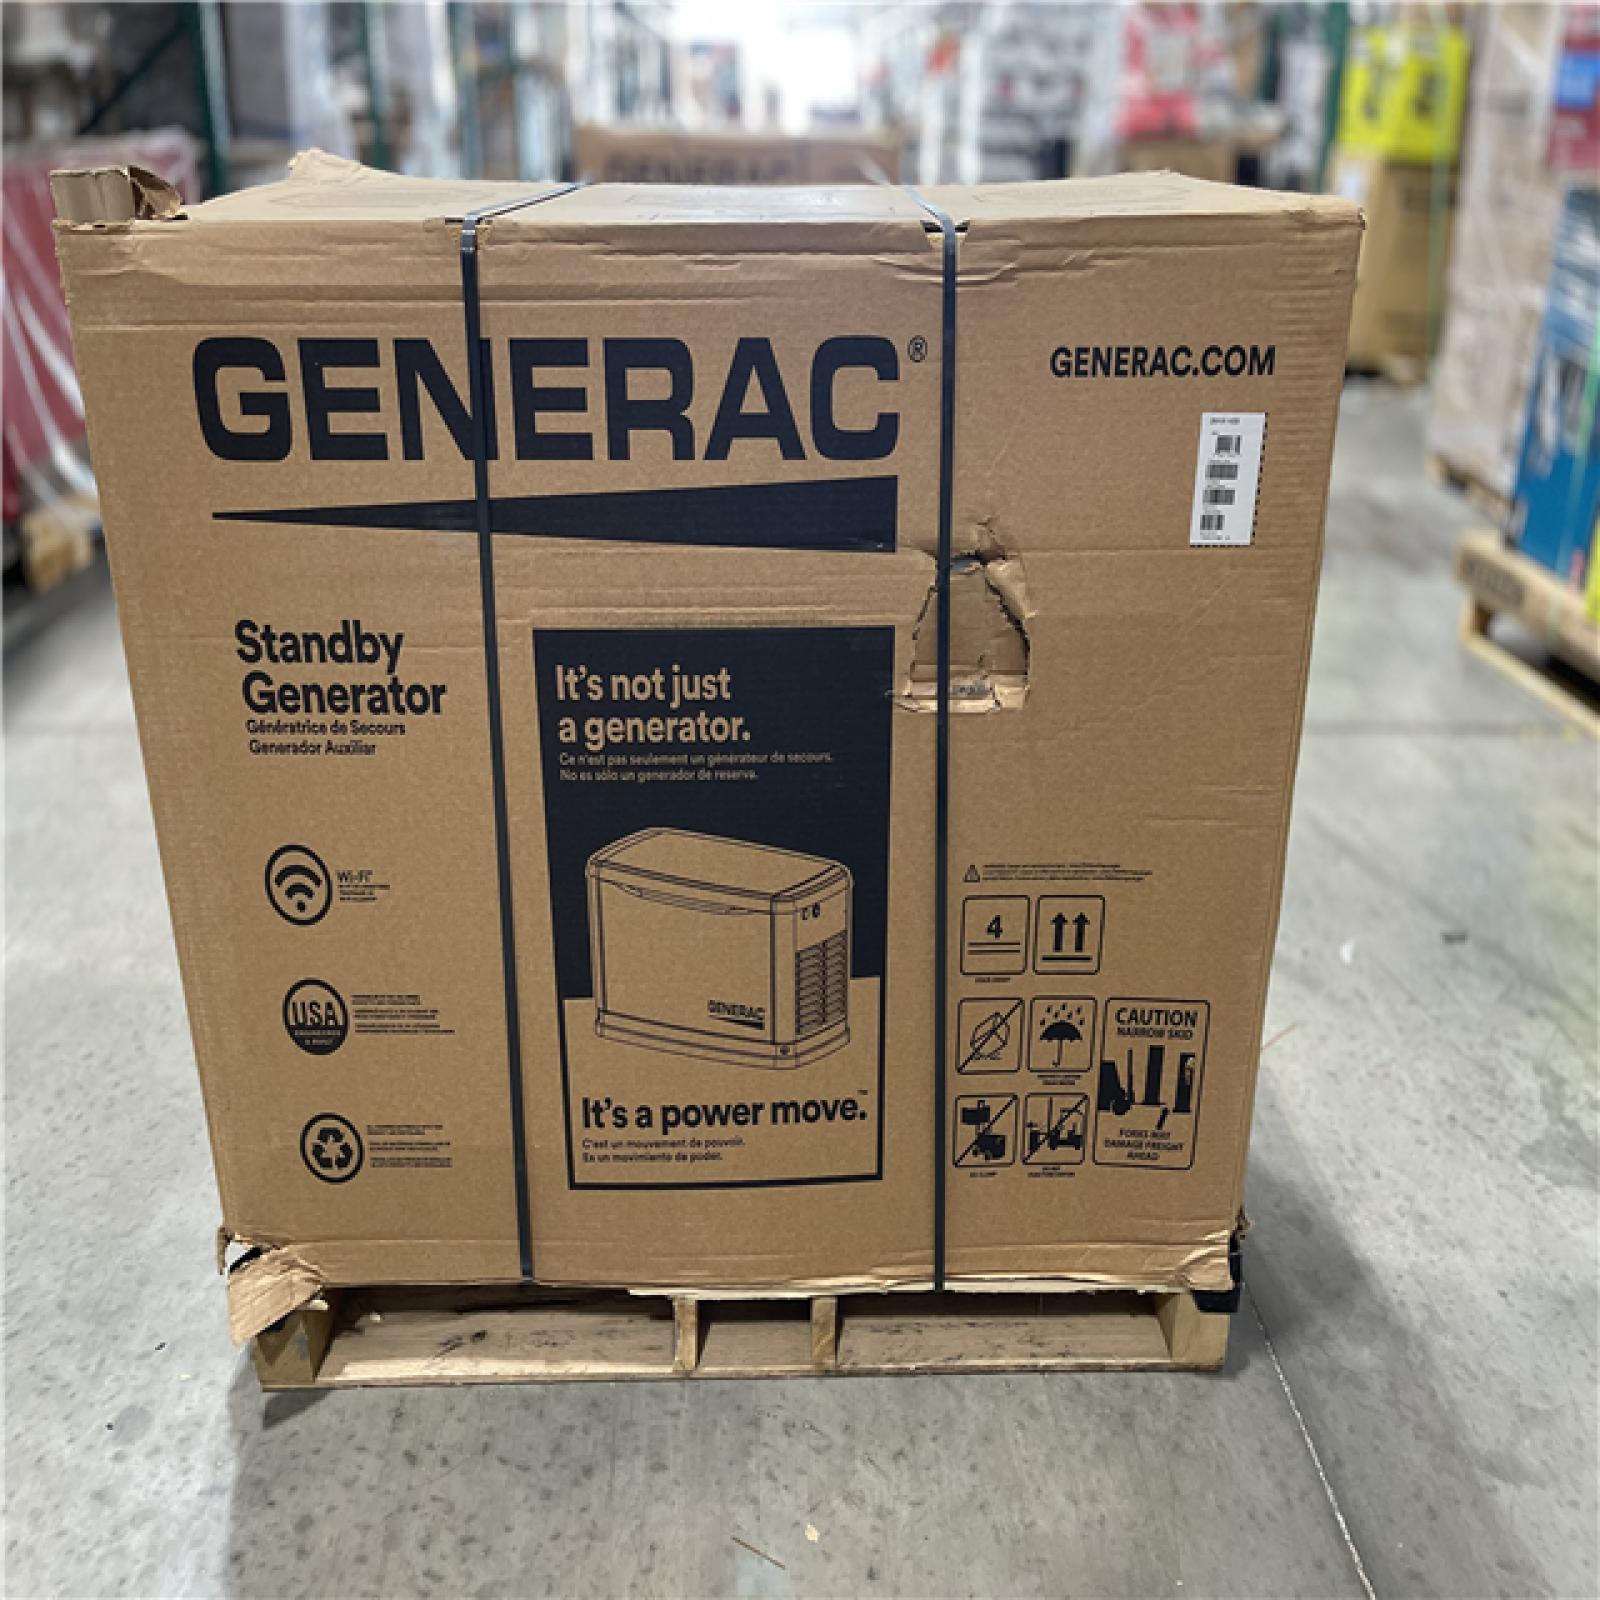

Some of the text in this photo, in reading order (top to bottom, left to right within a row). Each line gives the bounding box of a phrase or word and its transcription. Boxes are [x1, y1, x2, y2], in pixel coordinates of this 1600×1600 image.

[1050, 344, 1277, 378] GENERAC.COM
[192, 336, 900, 462] GENERAC
[235, 619, 405, 676] Standby
[242, 670, 448, 716] Generator
[555, 662, 732, 711] It's not just
[250, 739, 322, 755] Generador
[329, 719, 348, 736] de
[558, 709, 751, 752] a generator.
[986, 914, 1004, 938] 4
[1115, 1007, 1198, 1027] CAUTION
[582, 1096, 868, 1136] It's a power move.
